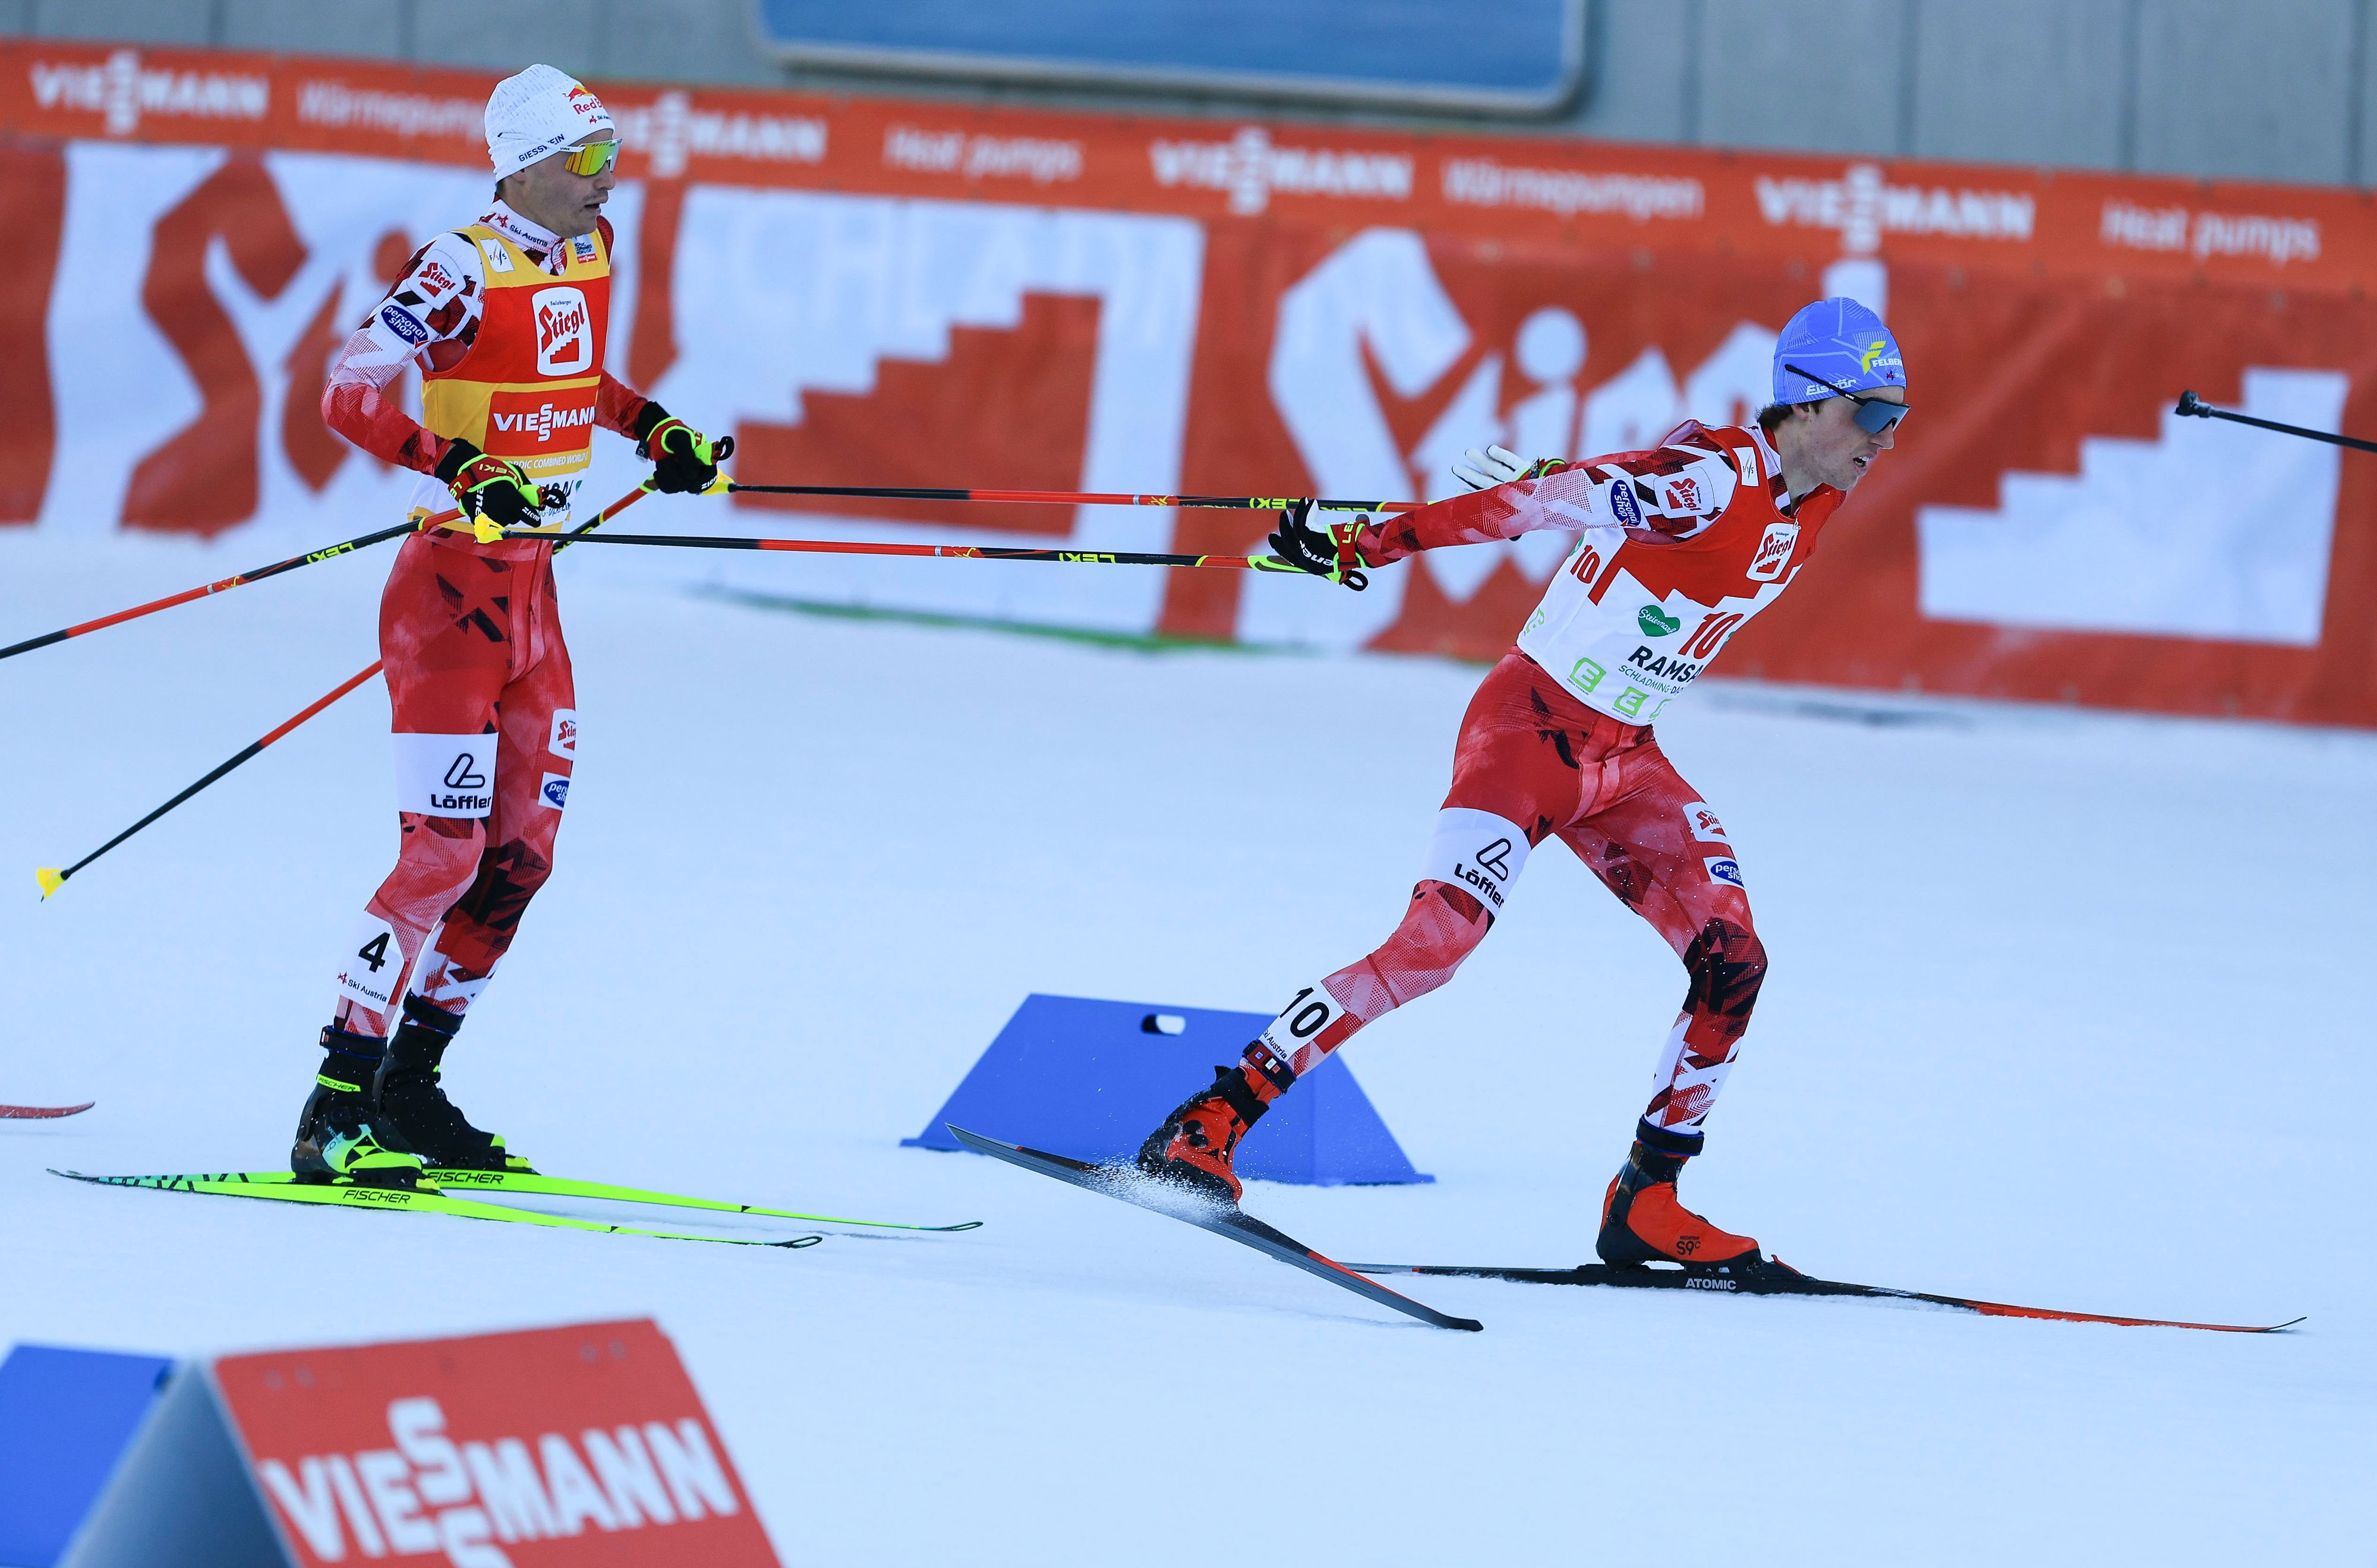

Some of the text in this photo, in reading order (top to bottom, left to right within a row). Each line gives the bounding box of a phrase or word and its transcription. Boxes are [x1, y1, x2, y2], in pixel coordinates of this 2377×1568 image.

[31, 51, 269, 135] VIESSMANN
[573, 98, 597, 115] Red
[612, 90, 827, 177] ESSMANN
[1149, 126, 1412, 215] VIESSMANN
[1754, 164, 2322, 266] VIESSMANN Heat pumps
[509, 224, 548, 247] Ski Austria
[418, 262, 456, 290] Stiegl
[384, 306, 426, 339] personal
[388, 316, 412, 336] shop
[538, 301, 585, 354] Stiegl
[1806, 378, 1857, 396] Eisär
[478, 463, 518, 481] LEKI
[534, 456, 566, 469] COMBINED
[1614, 494, 1628, 518] shop
[1618, 483, 1640, 523] personal
[1668, 477, 1703, 511] Stiegl
[307, 542, 355, 564] LEKI
[1058, 553, 1117, 564] LEKI
[1754, 533, 1795, 565] Stiegl
[1570, 544, 1601, 584] 10
[1638, 609, 1678, 635] Steiermark
[1678, 611, 1745, 660] 10
[431, 793, 491, 809] Löffler
[1454, 863, 1505, 909] Löffler
[358, 932, 390, 973] 4
[348, 979, 387, 1002] Ski Austria
[1279, 987, 1330, 1038] 10
[1266, 1036, 1287, 1059] Austria
[318, 1077, 357, 1091] FISCHER
[427, 1172, 505, 1185] FISCHER
[342, 1190, 411, 1204] FISCHER
[1685, 1277, 1736, 1291] ATOMIC
[261, 1396, 738, 1568] VIESSMANN
